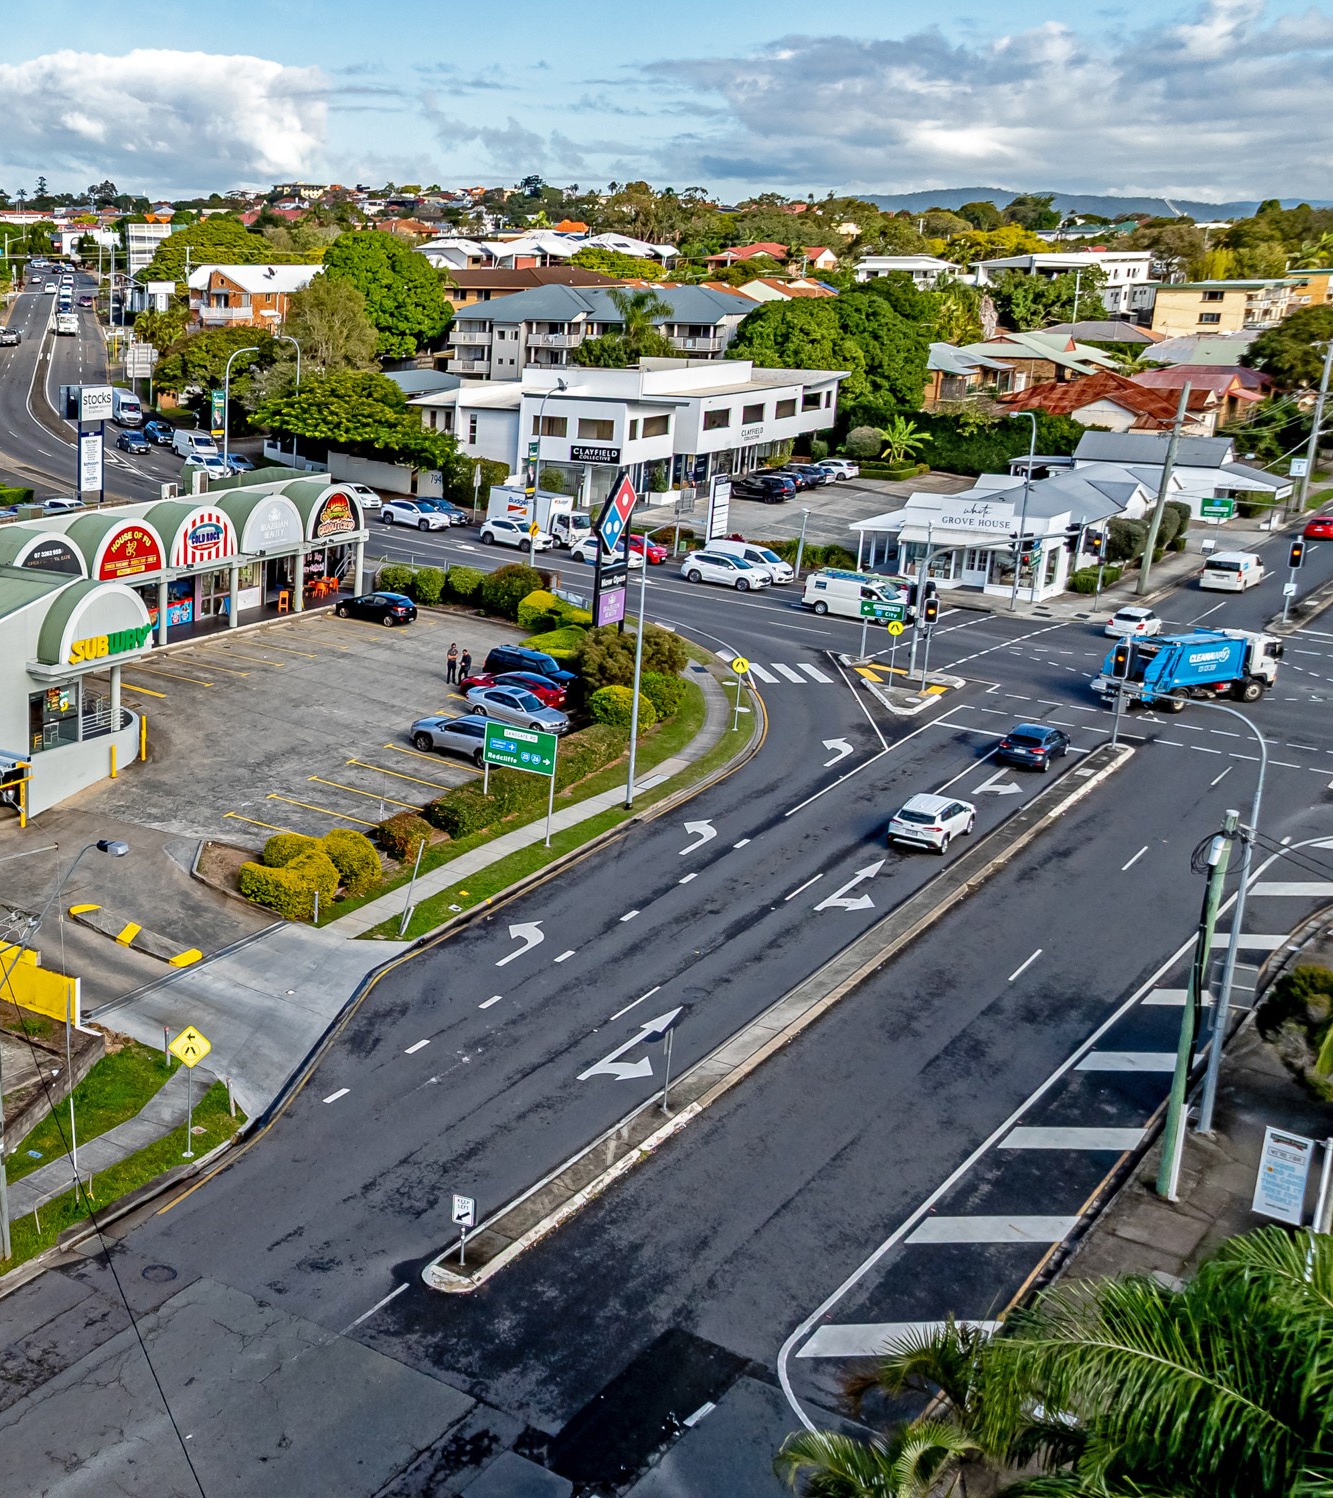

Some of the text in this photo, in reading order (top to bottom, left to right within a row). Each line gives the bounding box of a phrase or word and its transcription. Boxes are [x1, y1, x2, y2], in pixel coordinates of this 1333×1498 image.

[83, 392, 112, 406] stocks
[741, 427, 763, 436] CLAYFIELD
[573, 447, 618, 457] CLAYFIELD
[430, 474, 442, 484] 794
[508, 497, 529, 506] Budget
[963, 503, 993, 517] white
[942, 516, 1011, 529] GROVE HOUSE
[111, 531, 152, 553] HOUSE OF FU
[191, 531, 220, 545] COLD ROCK
[68, 623, 152, 665] SUBWAY
[1189, 649, 1227, 663] CLEANAWAY
[505, 731, 528, 740] SANDGATE
[488, 752, 517, 763] Redcliffe
